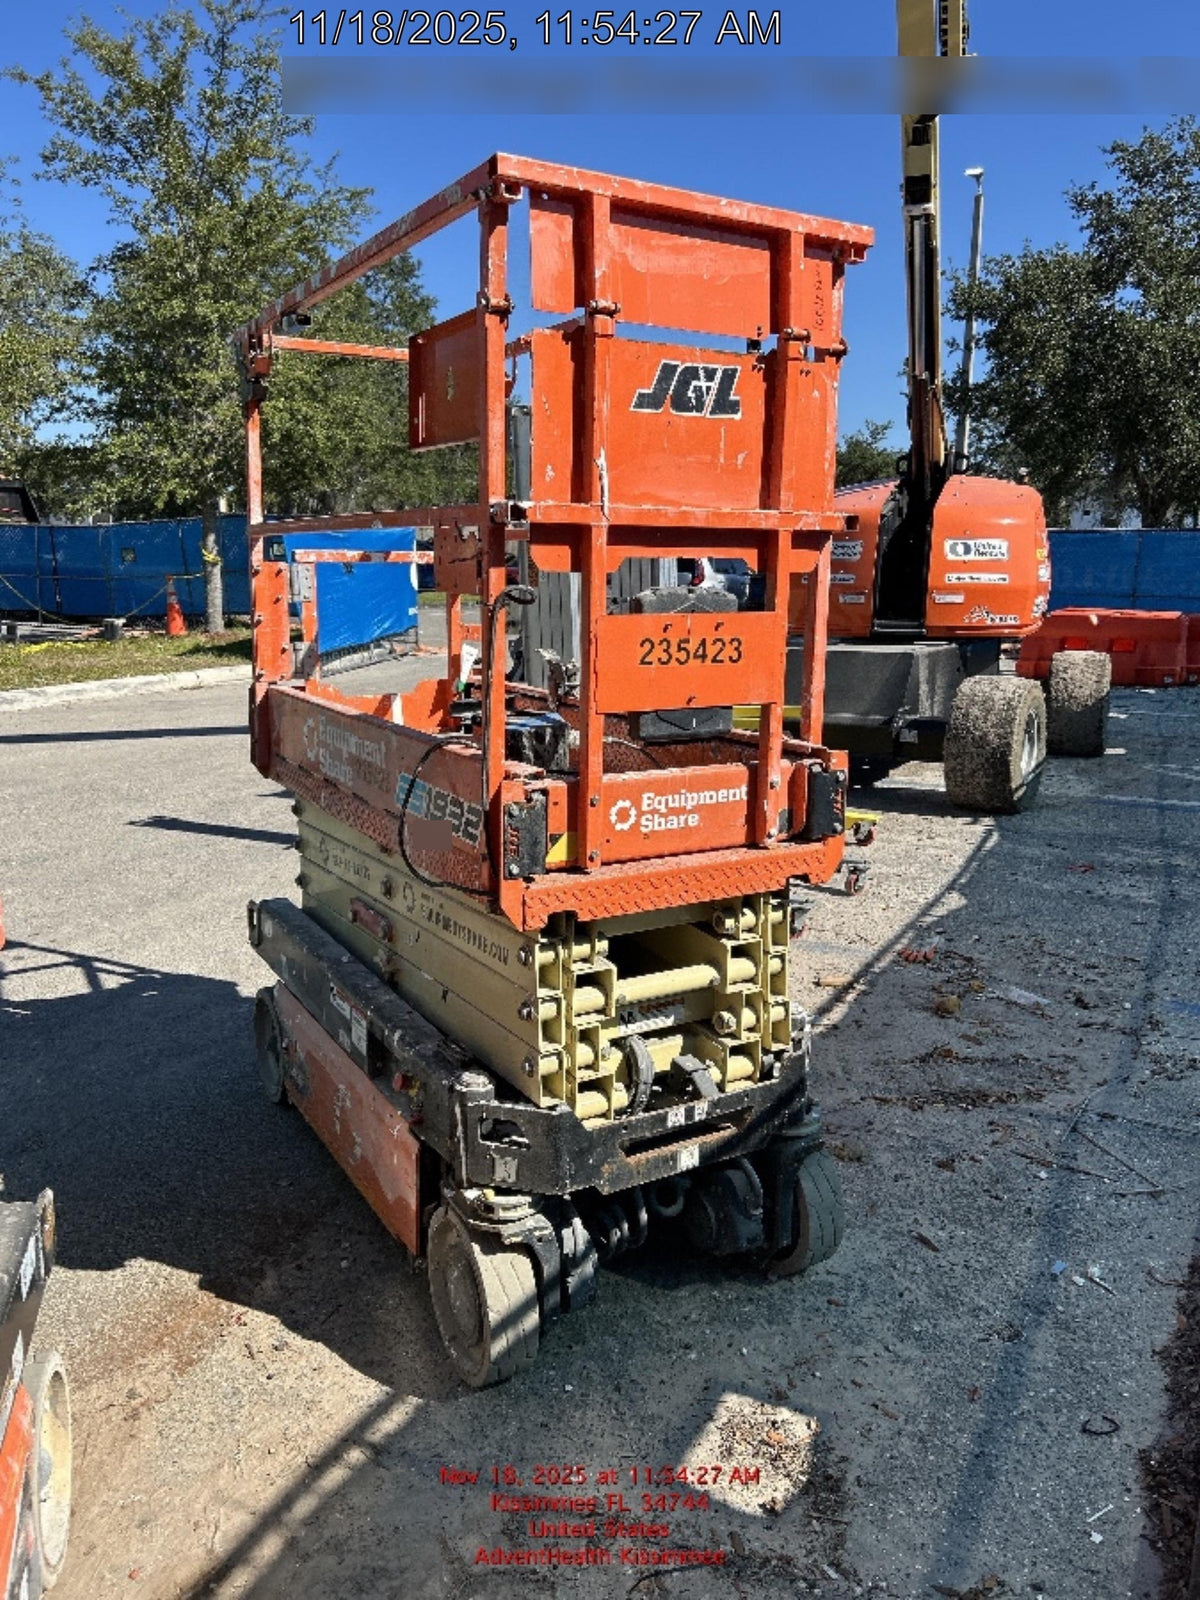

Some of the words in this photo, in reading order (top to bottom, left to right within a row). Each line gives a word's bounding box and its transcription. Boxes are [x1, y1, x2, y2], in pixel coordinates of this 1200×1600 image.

[638, 637, 743, 666] 235423
[641, 785, 748, 813] Equipment
[640, 811, 699, 832] Share
